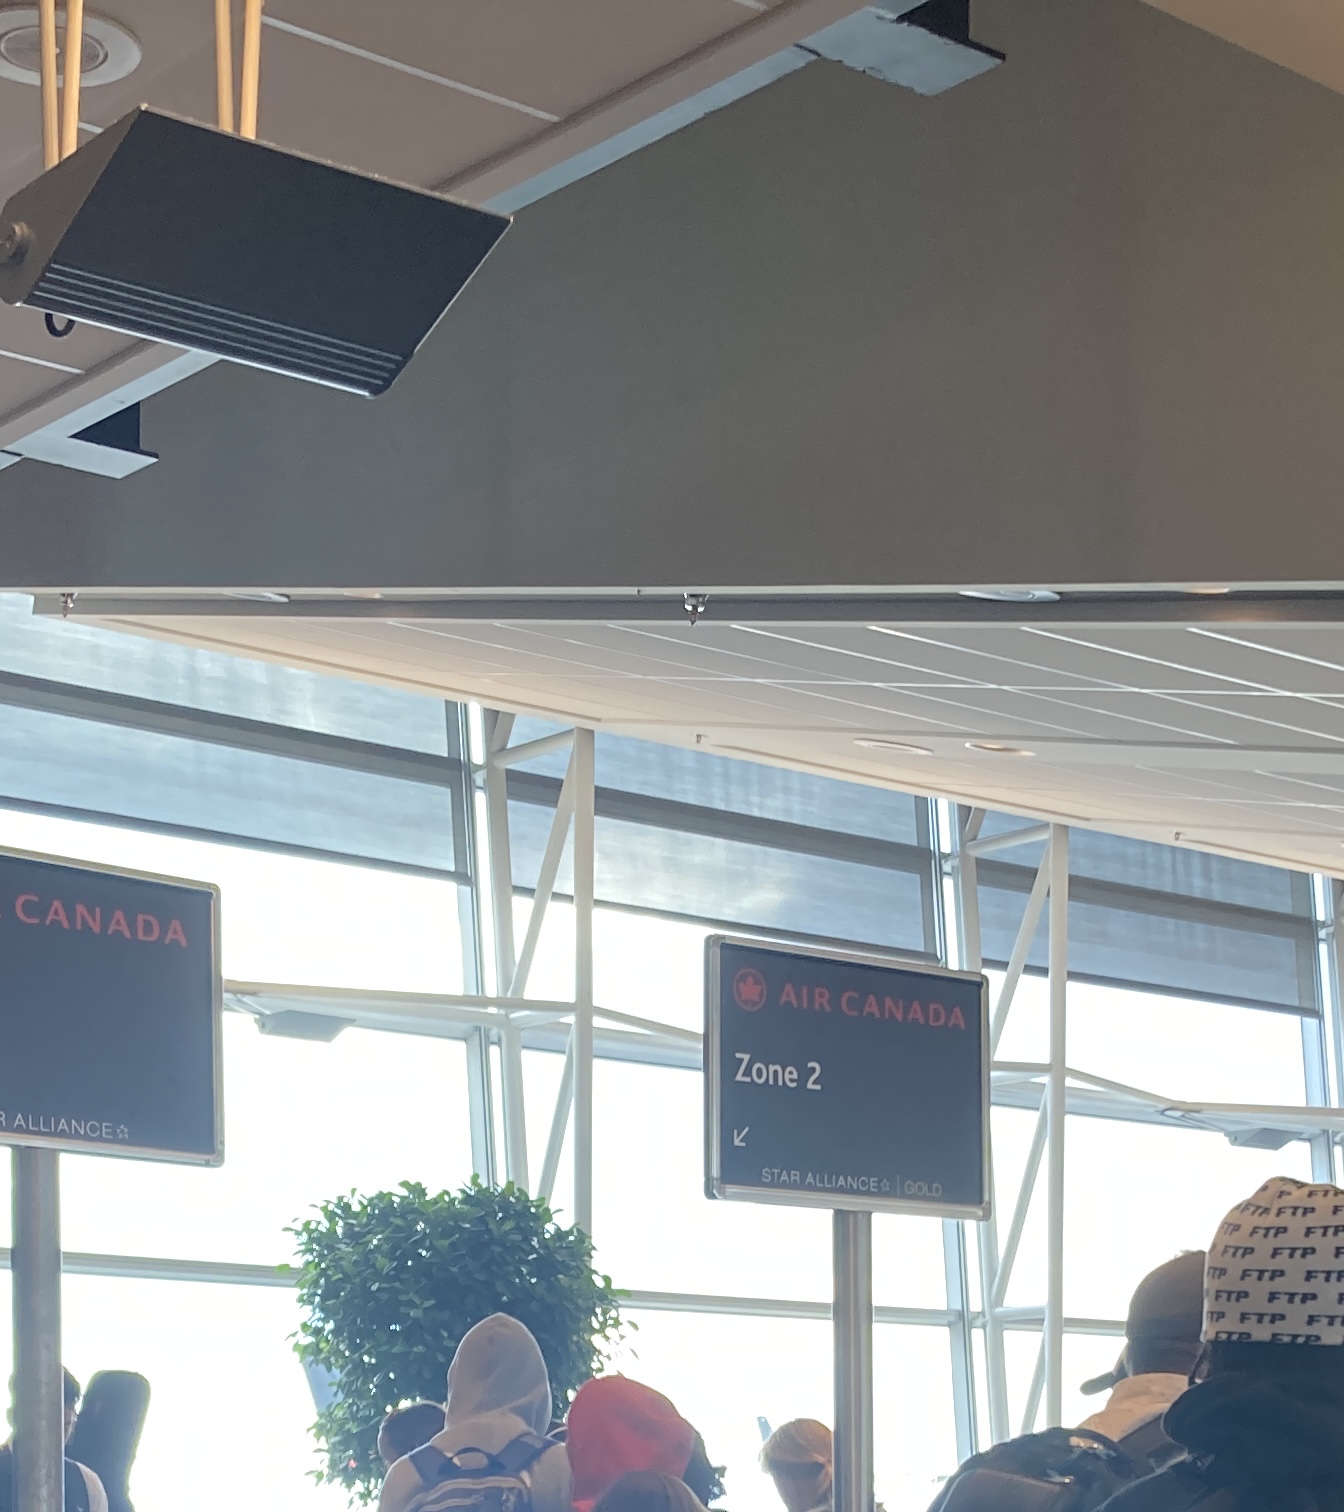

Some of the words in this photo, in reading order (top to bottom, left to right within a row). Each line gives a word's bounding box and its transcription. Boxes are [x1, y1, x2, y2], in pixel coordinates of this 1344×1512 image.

[15, 894, 188, 948] CANADA
[779, 982, 832, 1012] AIR
[840, 991, 966, 1031] CANADA
[734, 1052, 798, 1088] Zone
[806, 1061, 822, 1090] 2
[13, 1113, 113, 1139] ALLIANCE
[761, 1168, 800, 1185] STAR
[805, 1171, 879, 1192] ALLIANCE
[904, 1180, 943, 1197] GOLD
[1276, 1206, 1316, 1217] FTP
[1249, 1226, 1288, 1238] FTP
[1221, 1245, 1255, 1259] FTP
[1270, 1247, 1316, 1259] FTP
[1240, 1269, 1286, 1281] FTP
[1215, 1290, 1250, 1303] FTP
[1267, 1291, 1318, 1304] FTP
[1240, 1312, 1286, 1324] FTP
